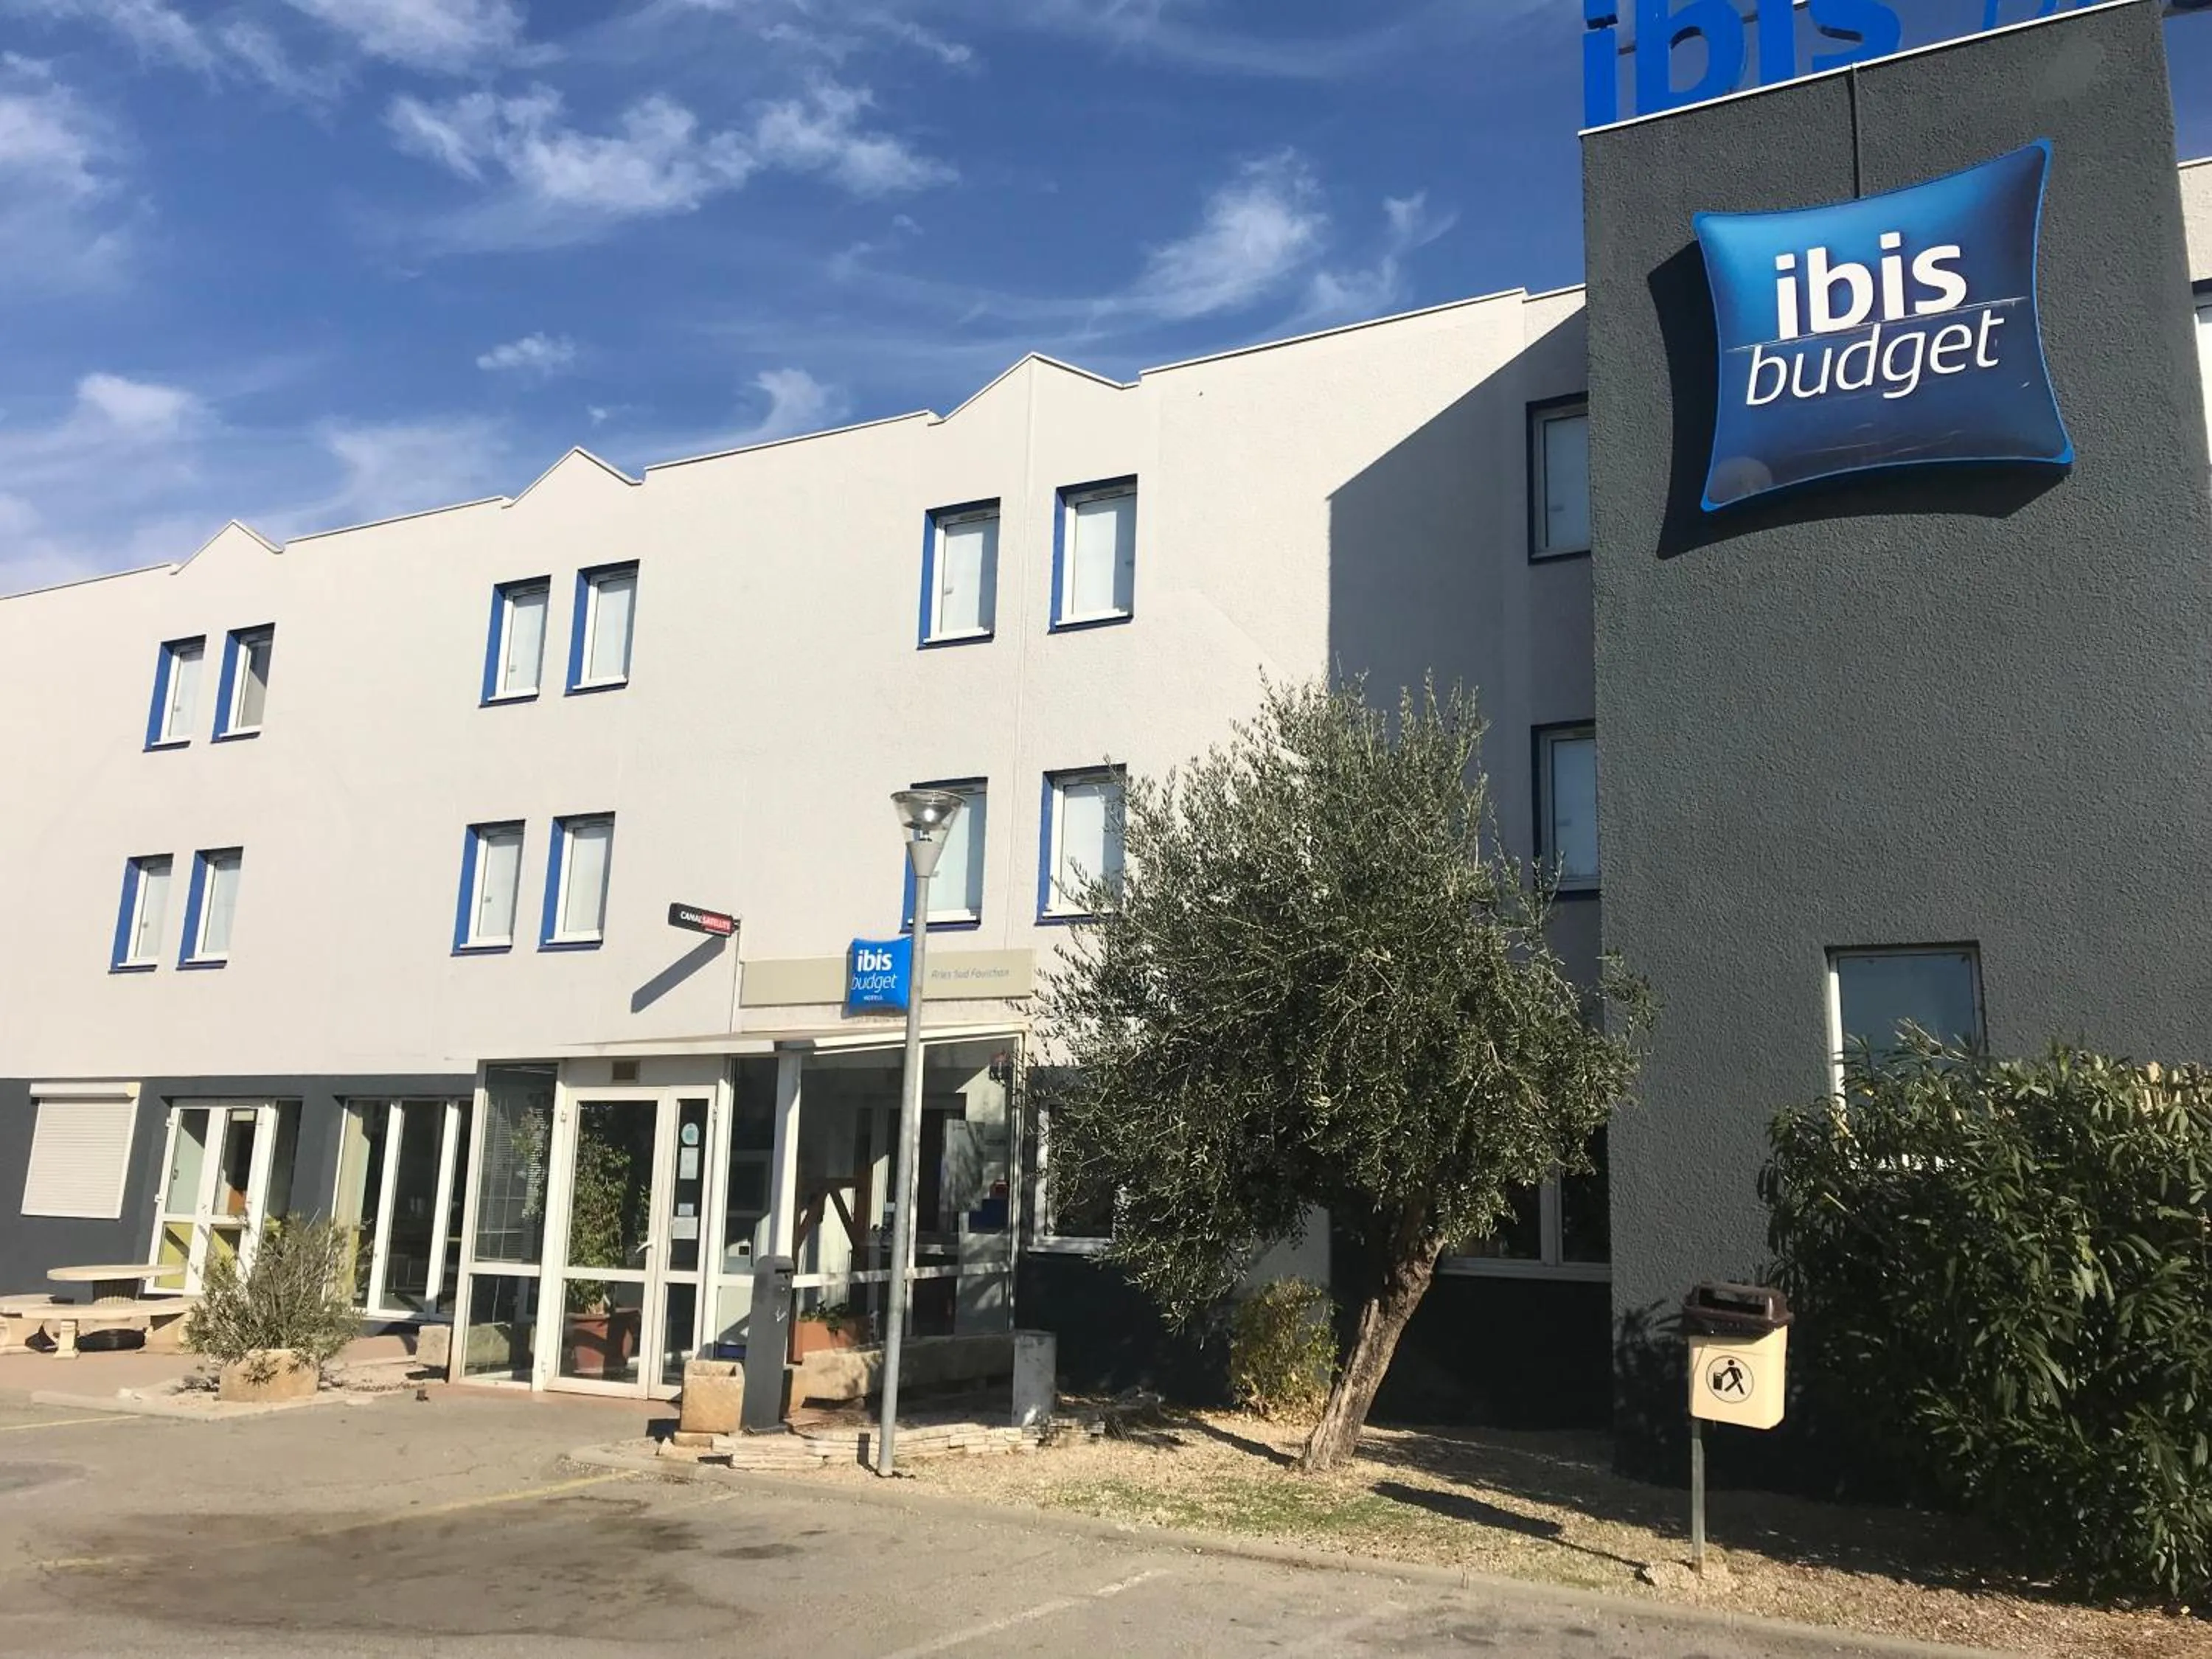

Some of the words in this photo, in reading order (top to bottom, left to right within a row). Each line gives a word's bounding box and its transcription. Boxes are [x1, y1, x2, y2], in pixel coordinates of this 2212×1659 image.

[1775, 232, 1967, 340] ibis
[1746, 309, 2004, 406] budget
[851, 973, 897, 993] budget
[858, 948, 892, 972] ibis
